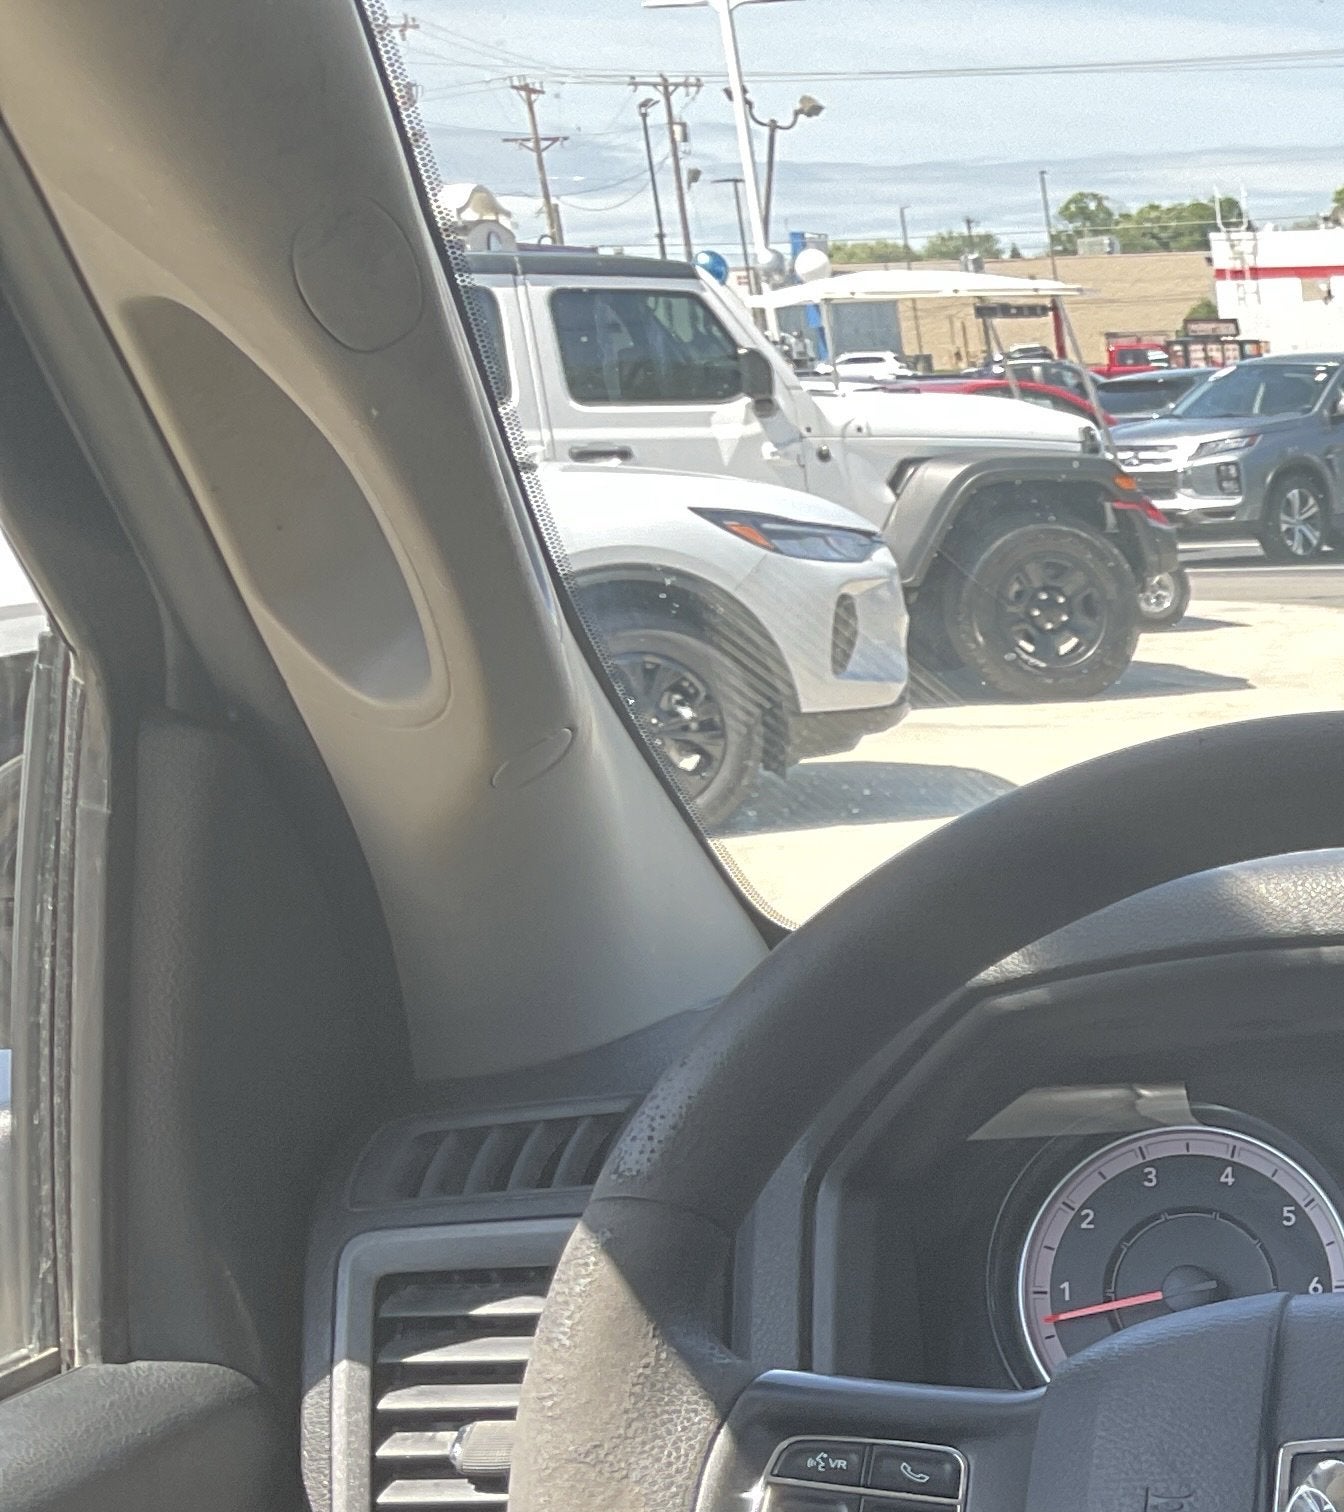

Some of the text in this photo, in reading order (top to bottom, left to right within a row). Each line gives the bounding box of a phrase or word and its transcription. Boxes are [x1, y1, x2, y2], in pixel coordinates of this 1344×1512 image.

[1143, 1167, 1157, 1187] 3
[1219, 1166, 1235, 1186] 4
[1080, 1208, 1095, 1229] 2
[1282, 1206, 1296, 1226] 5
[1059, 1281, 1071, 1301] 1
[1308, 1276, 1323, 1294] 6
[829, 1457, 847, 1470] VR
